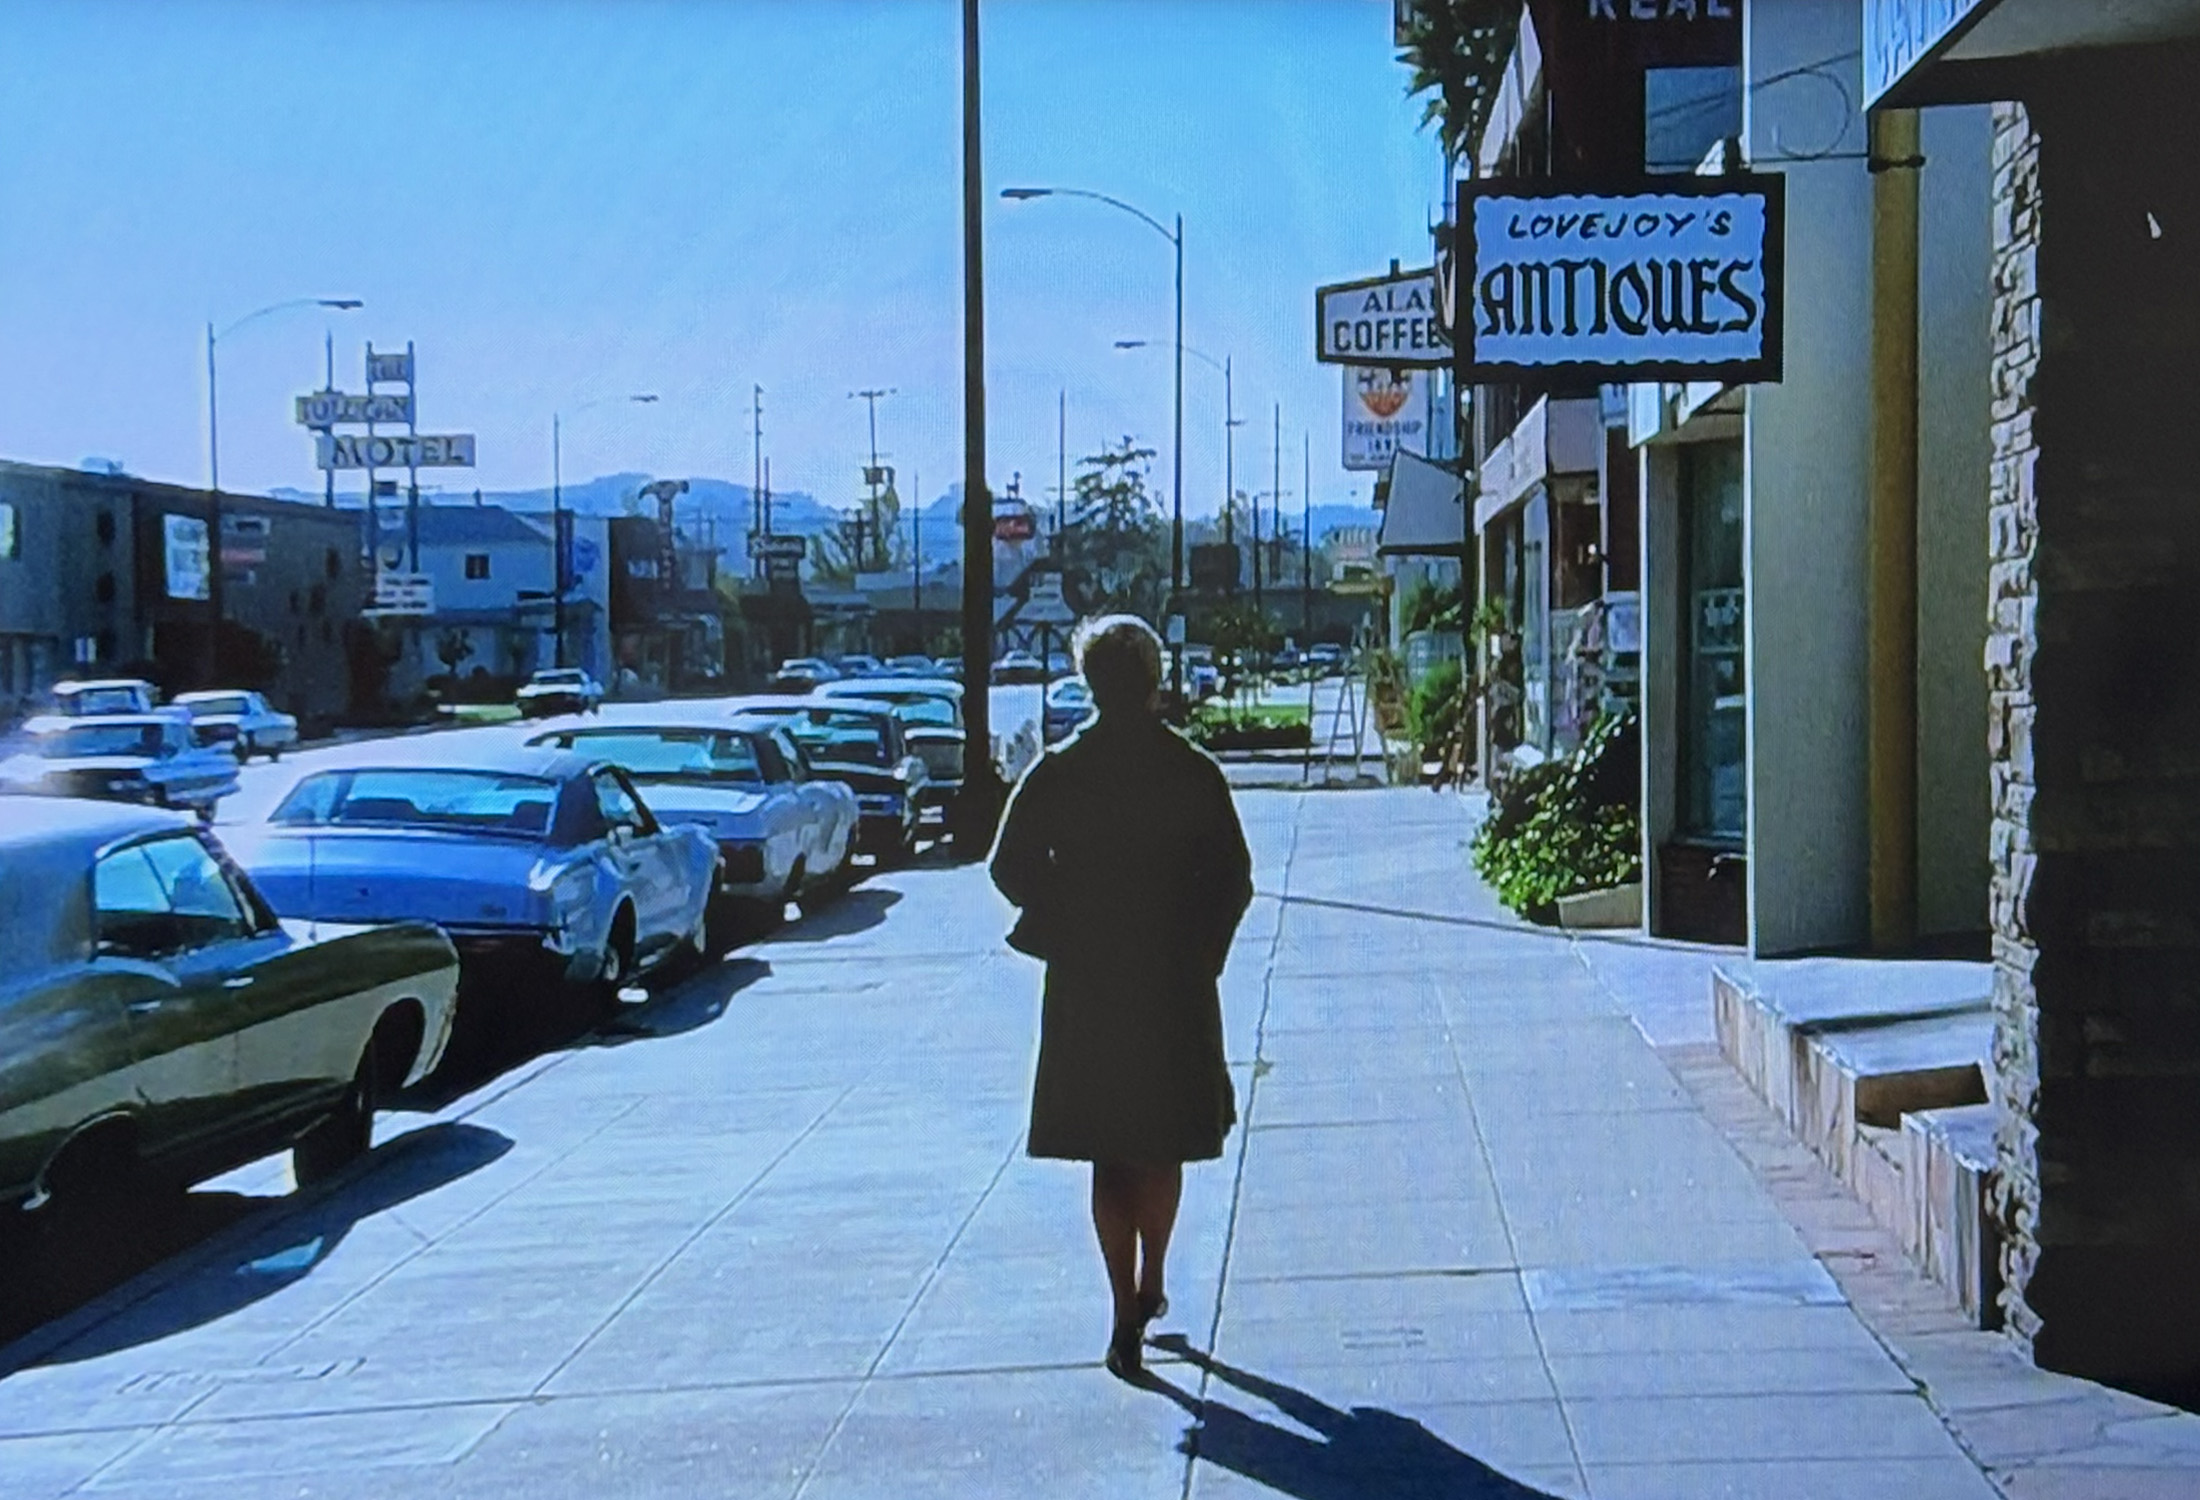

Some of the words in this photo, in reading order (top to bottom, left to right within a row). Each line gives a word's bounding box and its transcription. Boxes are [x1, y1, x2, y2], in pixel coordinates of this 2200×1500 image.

[1508, 210, 1732, 239] LOVEJOY'S
[1362, 288, 1434, 313] ALA
[1480, 257, 1757, 336] ANTIQUES
[1333, 317, 1440, 352] COFFEE
[332, 434, 465, 467] MOTEL
